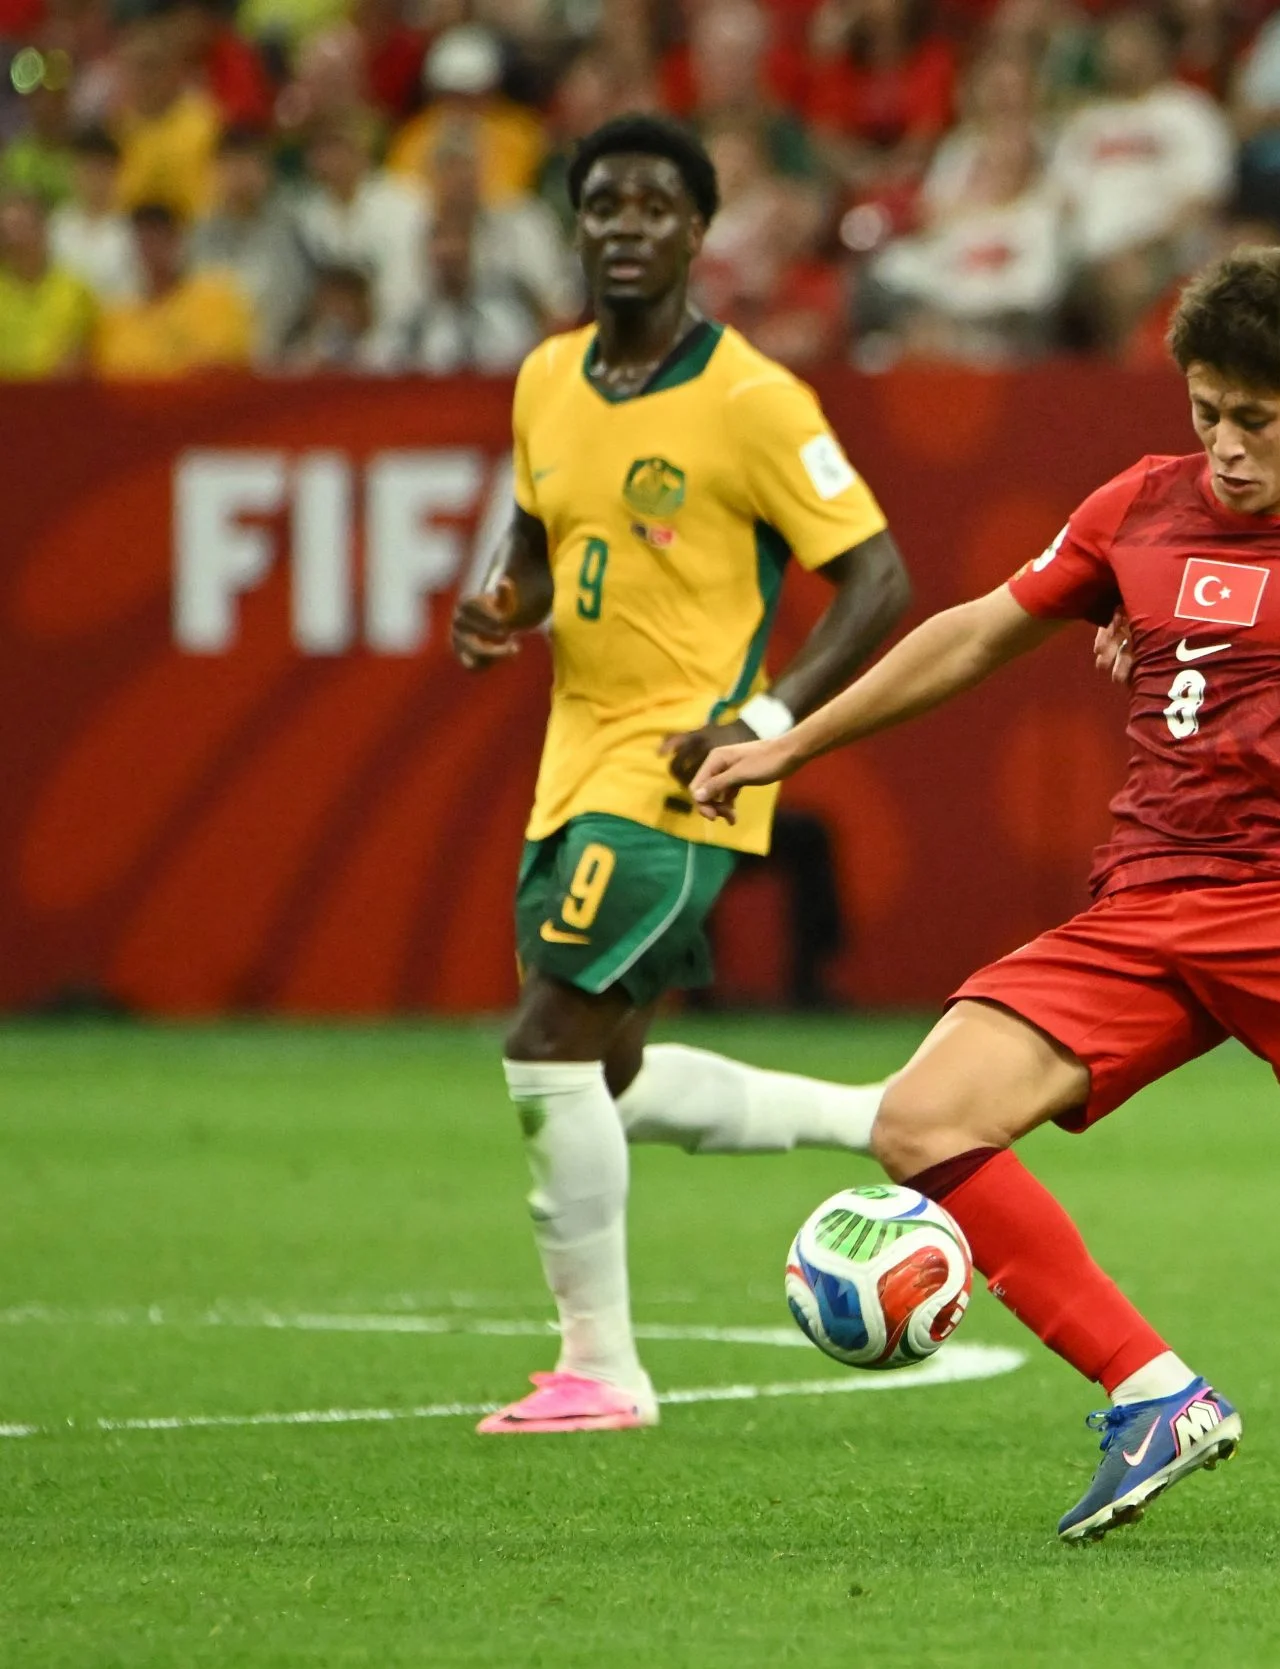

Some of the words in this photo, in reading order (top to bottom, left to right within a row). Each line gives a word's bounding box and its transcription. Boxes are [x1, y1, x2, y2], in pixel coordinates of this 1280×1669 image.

[577, 538, 608, 622] 9
[1163, 669, 1207, 740] 8
[561, 843, 616, 930] 9
